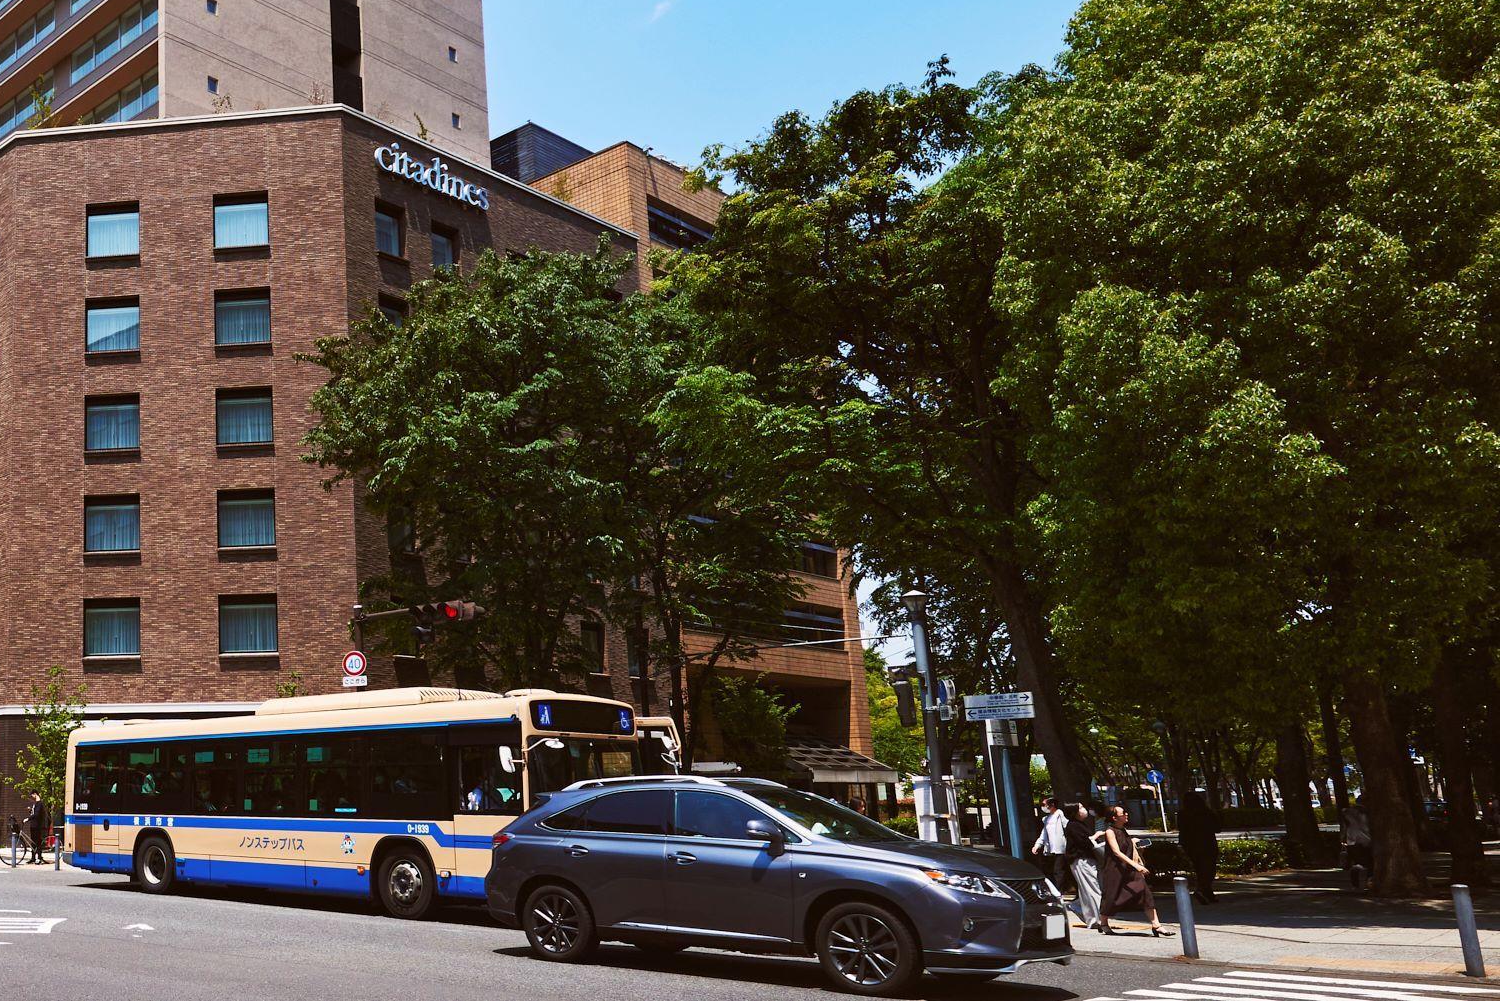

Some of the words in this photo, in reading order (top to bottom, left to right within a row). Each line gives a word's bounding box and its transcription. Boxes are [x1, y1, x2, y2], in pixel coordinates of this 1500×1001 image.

[348, 659, 360, 669] 40
[407, 824, 429, 834] 0-1939
[240, 836, 305, 850] ノンステップバス
